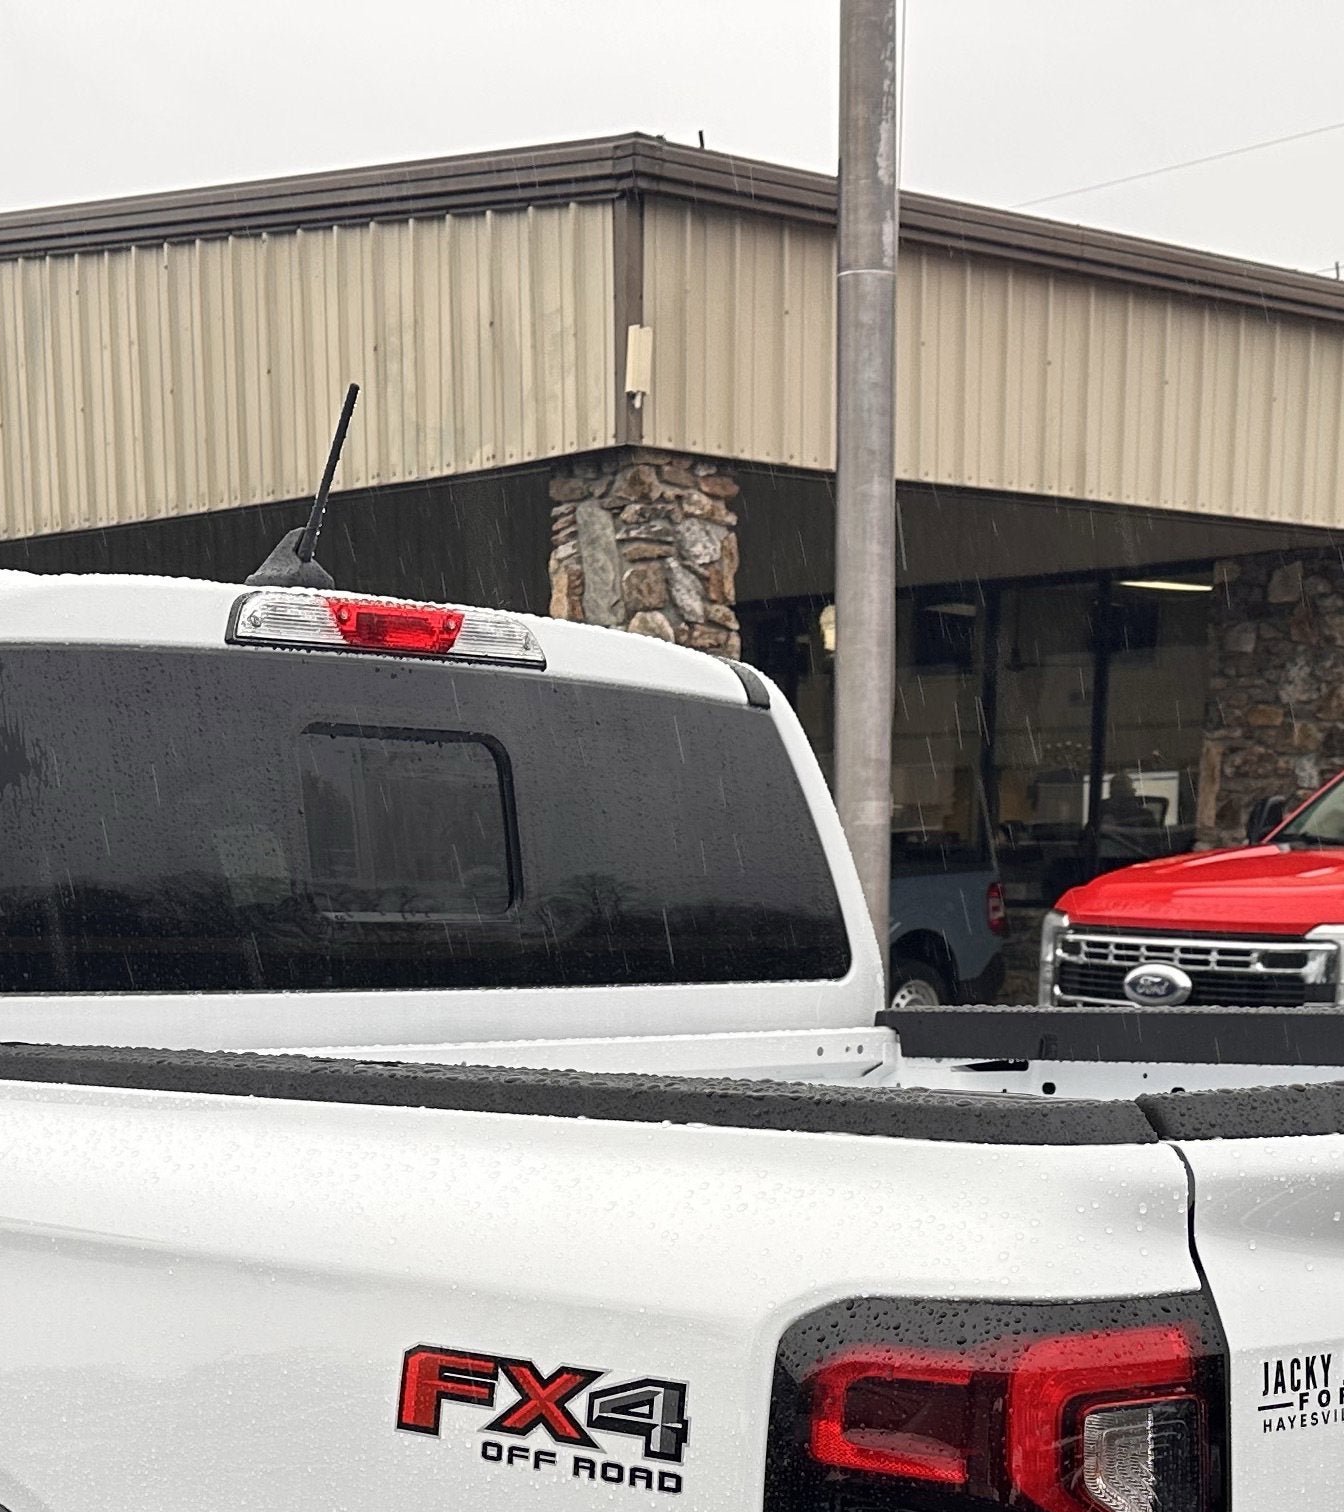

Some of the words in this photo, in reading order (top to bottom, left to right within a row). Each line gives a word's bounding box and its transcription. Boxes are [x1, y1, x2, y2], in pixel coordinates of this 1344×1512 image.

[1262, 1353, 1332, 1397] JACKY
[395, 1341, 692, 1466] FX4
[481, 1440, 557, 1470] OFF
[572, 1455, 683, 1494] ROAD
